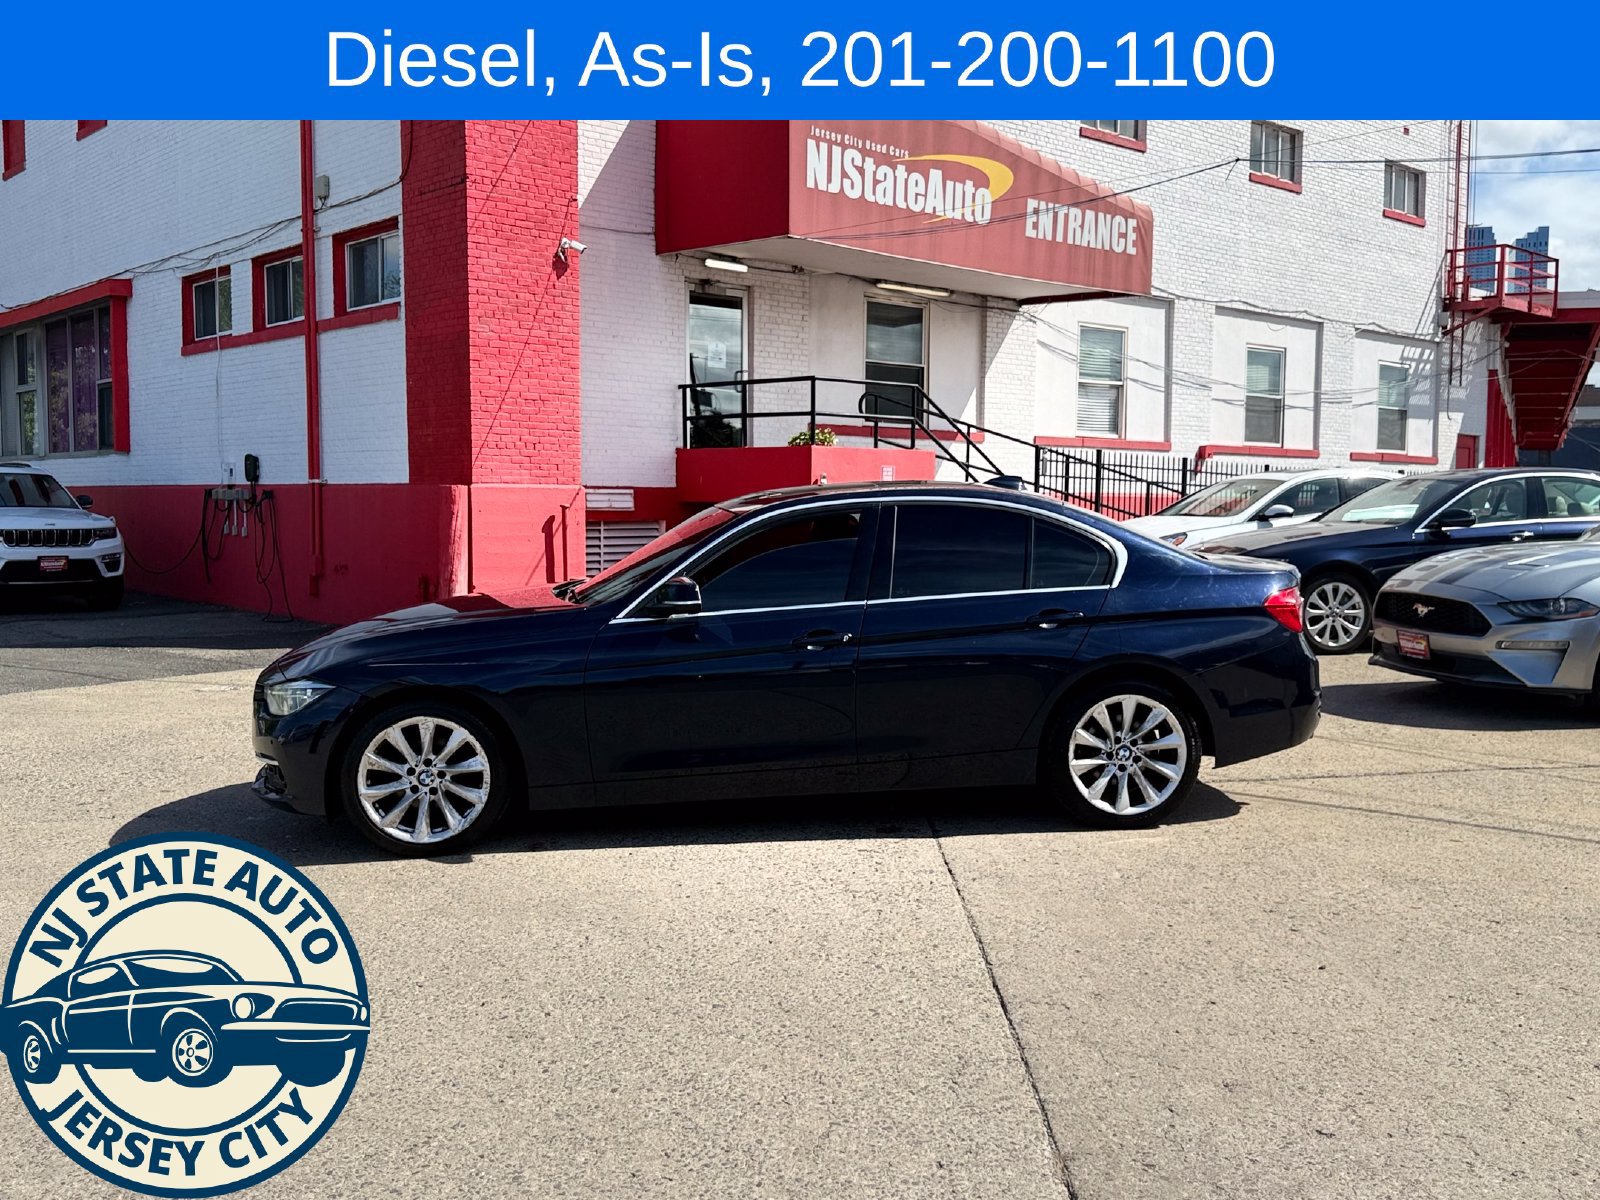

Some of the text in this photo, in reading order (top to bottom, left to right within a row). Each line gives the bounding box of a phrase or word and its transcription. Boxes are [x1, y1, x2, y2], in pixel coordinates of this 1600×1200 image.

[810, 125, 910, 160] Jersey City Used Cars
[805, 138, 992, 225] NJStateAuto
[1025, 198, 1138, 256] ENTRANCE
